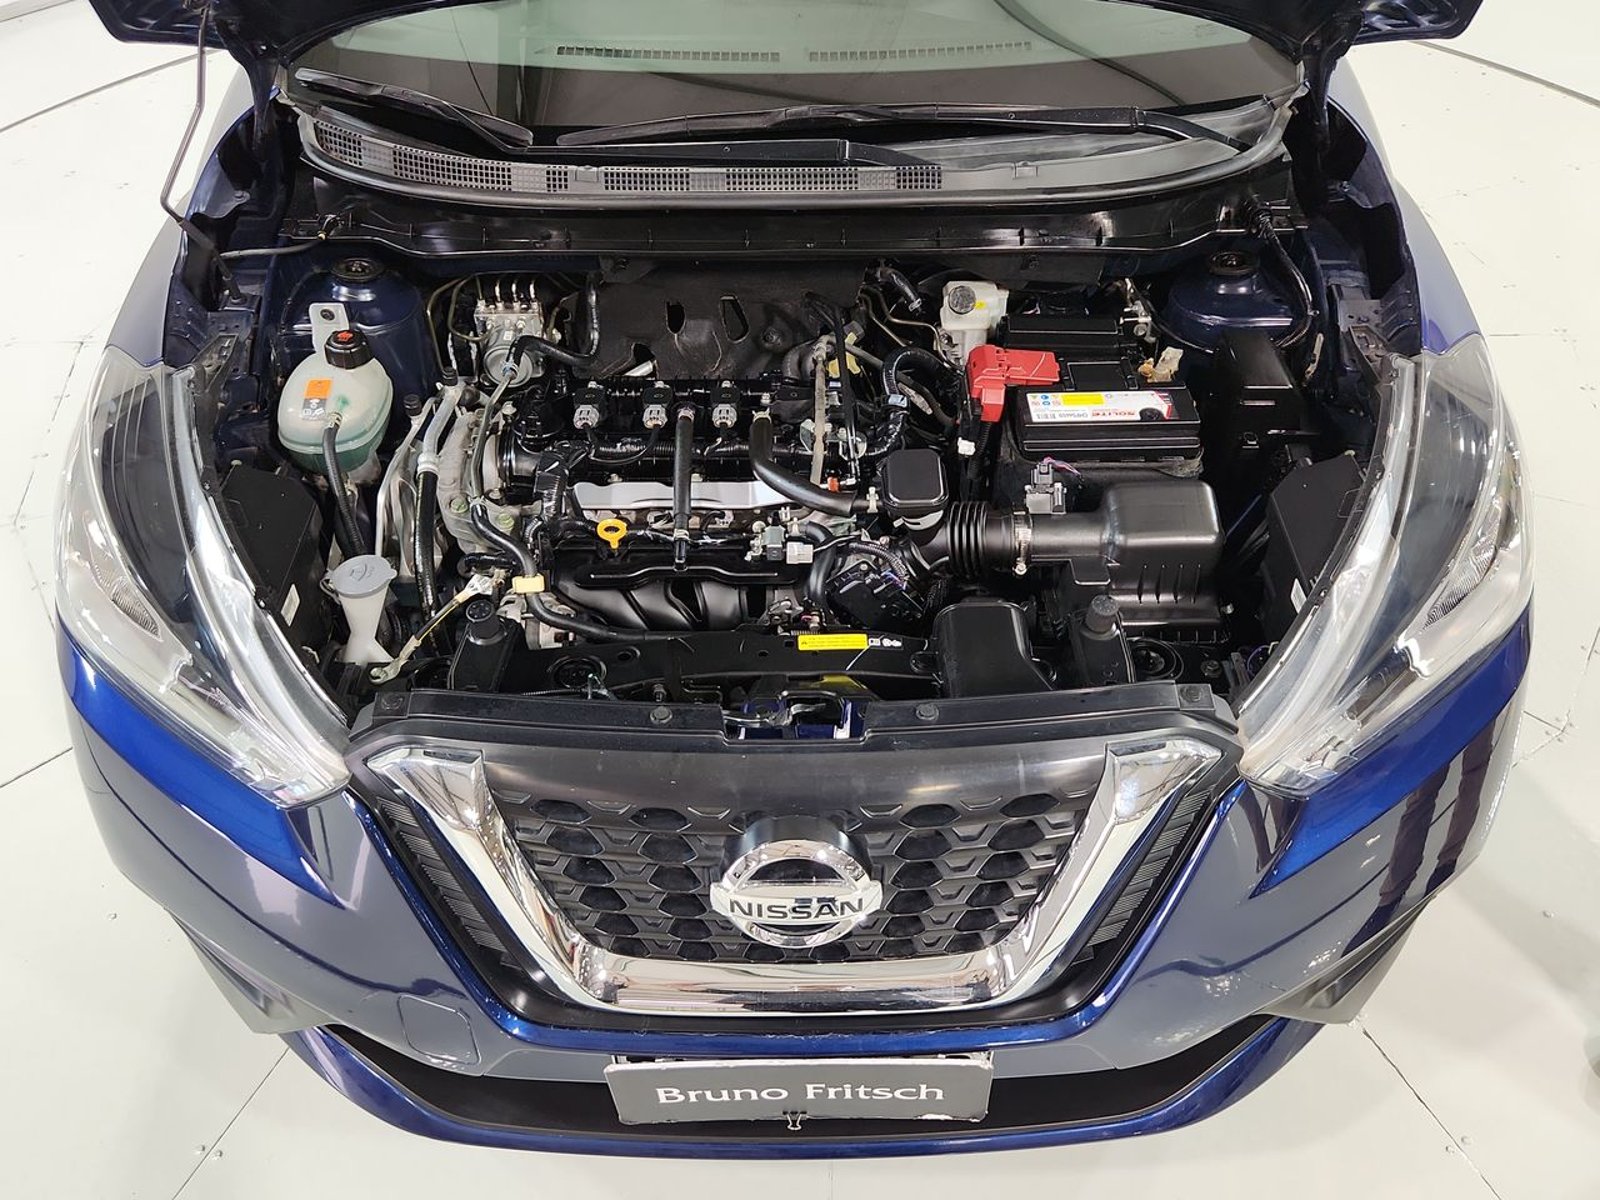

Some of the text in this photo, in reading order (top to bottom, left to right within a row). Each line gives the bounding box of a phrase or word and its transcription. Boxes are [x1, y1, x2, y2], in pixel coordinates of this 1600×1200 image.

[729, 898, 863, 920] NISSAN
[655, 1083, 945, 1103] Bruno Fritsch
